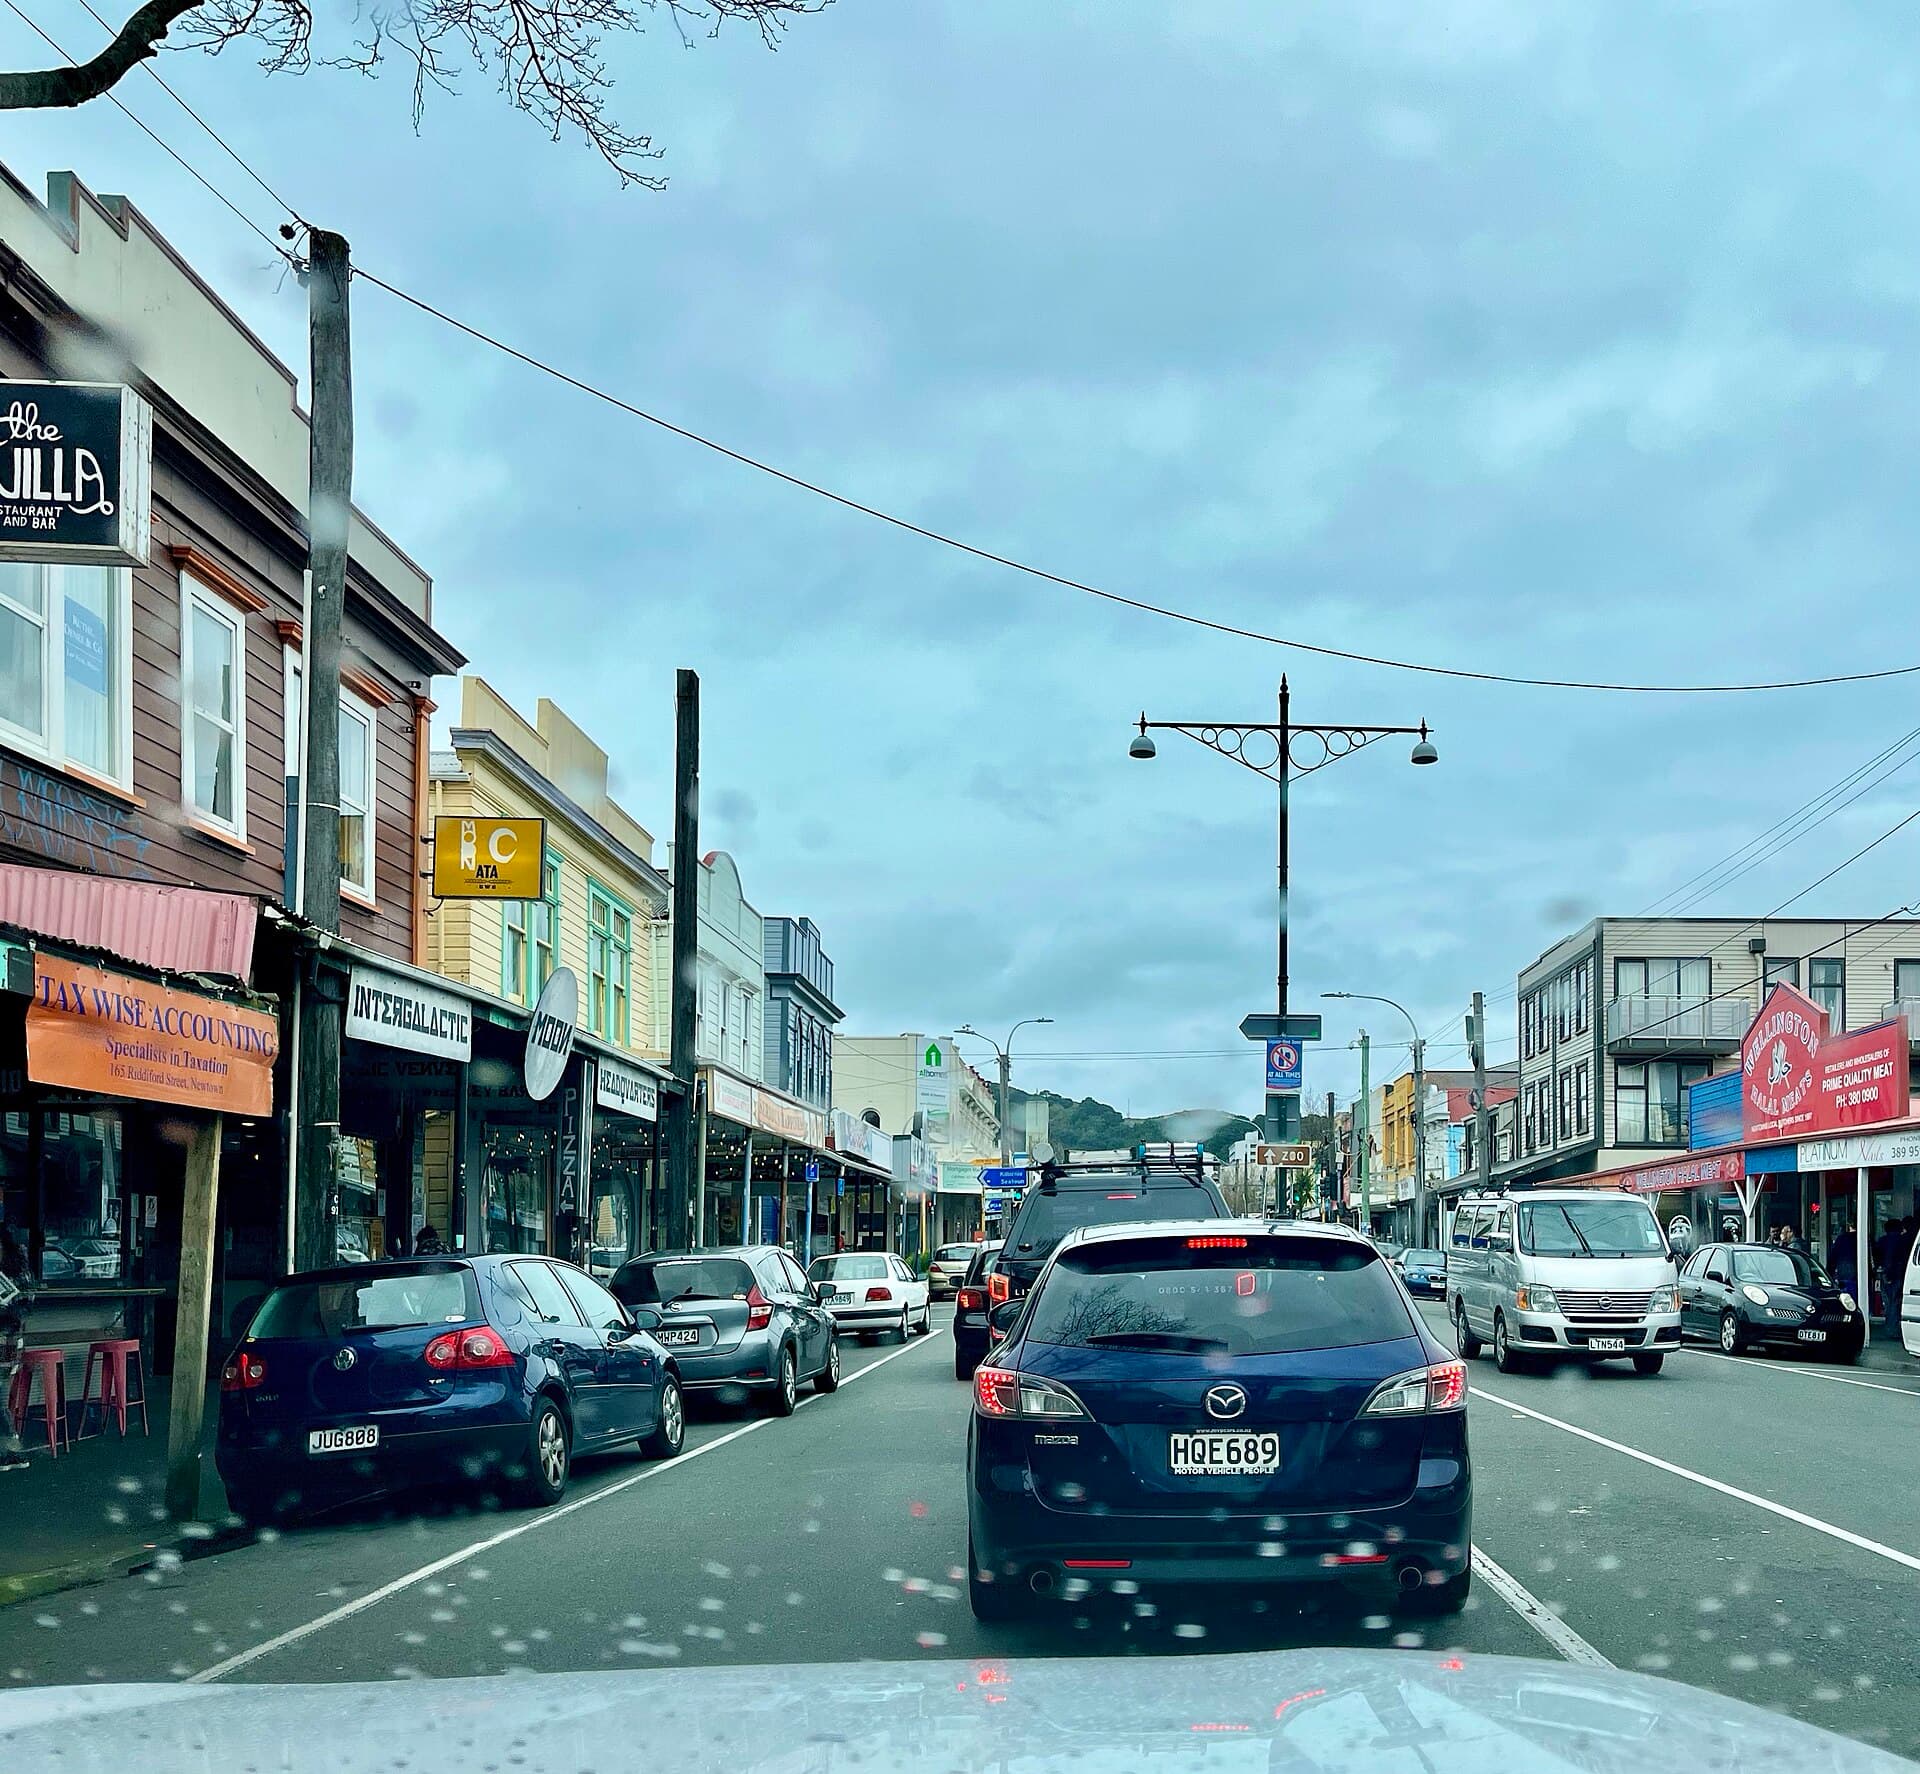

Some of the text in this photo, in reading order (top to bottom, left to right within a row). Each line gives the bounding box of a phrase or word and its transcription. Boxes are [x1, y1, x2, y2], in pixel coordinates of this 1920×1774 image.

[3, 516, 57, 530] AND BAR
[40, 975, 274, 1057] TAX WISE ACCOUNTING
[530, 1010, 573, 1056] MOON
[1744, 1010, 1820, 1077] WELLINGTON
[105, 1034, 229, 1076] Specialists in Taxation
[1883, 1048, 1890, 1058] OF
[109, 1062, 126, 1077] 165
[190, 1077, 224, 1095] Newtown
[1822, 1061, 1894, 1093] PRIME QUALITY MEAT
[1750, 1068, 1813, 1116] HALAL MEATS
[1835, 1086, 1879, 1109] PH: 380 0900
[561, 1087, 577, 1198] PIZZA
[1800, 1138, 1849, 1164] PLATINUM
[1891, 1144, 1920, 1159] 389 95
[1281, 1151, 1305, 1162] ZOO
[1636, 1160, 1722, 1189] WELLINGTON HALAL MEAT
[1590, 1339, 1624, 1350] LTN544
[312, 1428, 377, 1450] JUG808
[1034, 1434, 1079, 1445] mazda
[1173, 1437, 1277, 1465] HQE689
[1174, 1466, 1275, 1475] MOTOR VEHICLE PEOPLE
